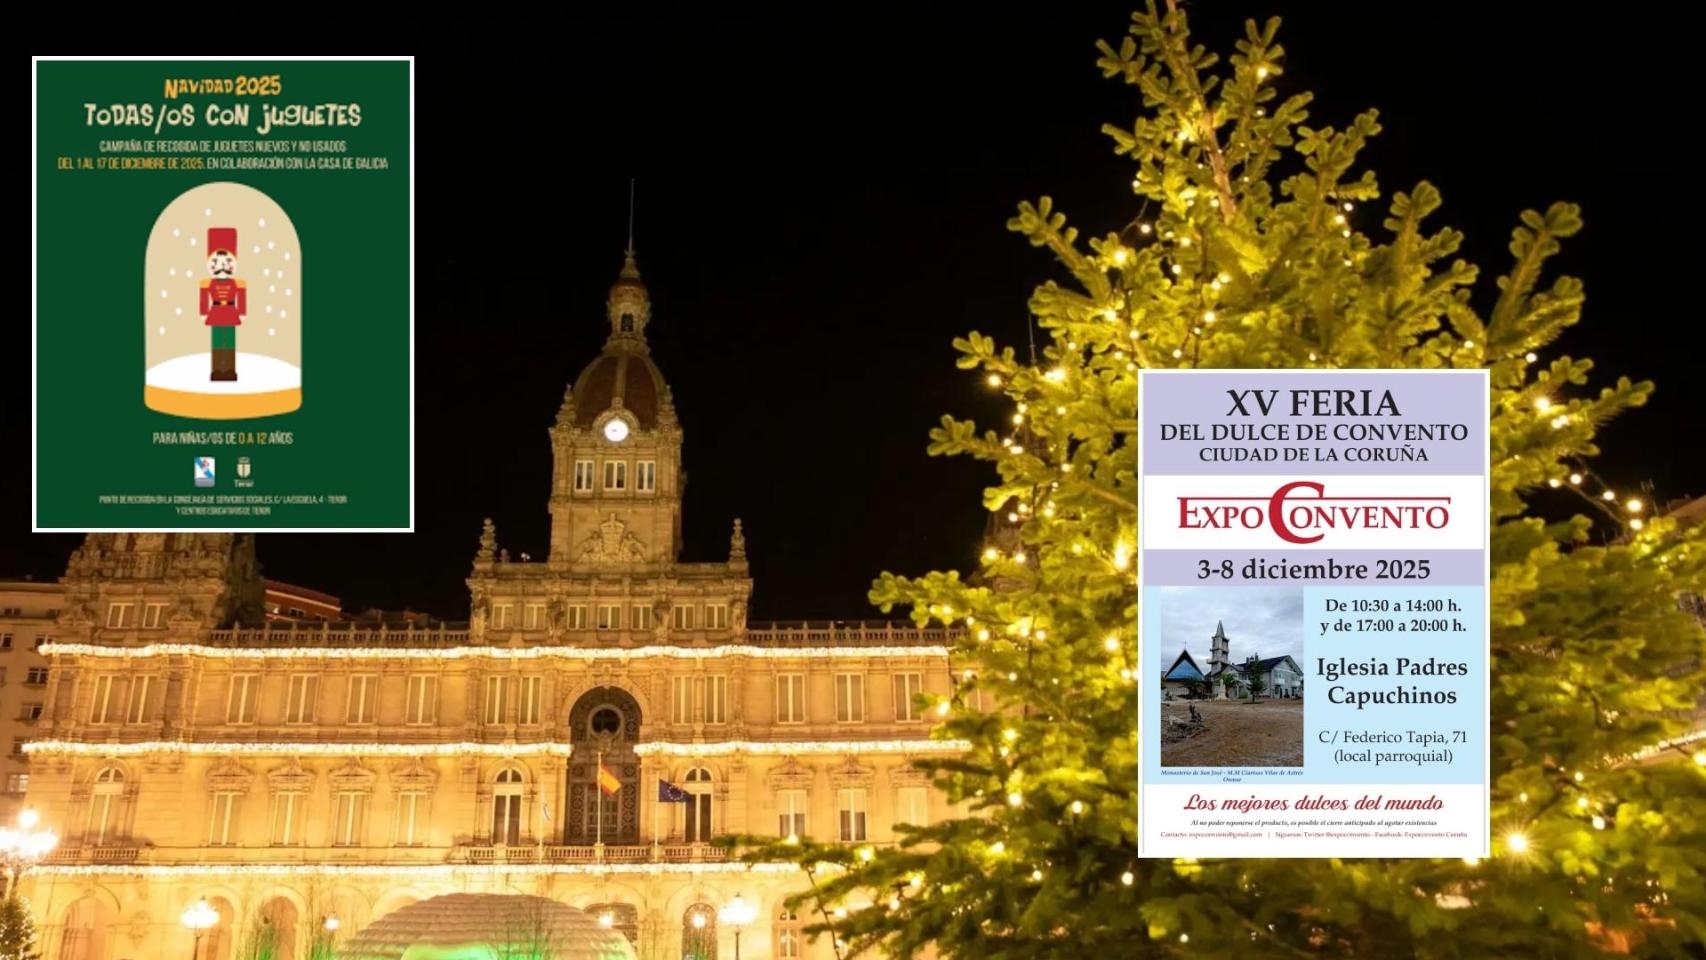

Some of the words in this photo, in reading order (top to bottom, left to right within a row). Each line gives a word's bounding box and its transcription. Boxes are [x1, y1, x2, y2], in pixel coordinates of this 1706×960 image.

[235, 75, 282, 96] 2025
[99, 139, 142, 153] CAMPAÑA
[144, 140, 155, 153] DE
[157, 140, 198, 153] RECOGIDA
[200, 140, 211, 153] DE
[214, 140, 254, 153] JUGUETES
[255, 140, 290, 153] NUEVOS
[290, 140, 297, 153] Y
[299, 140, 312, 153] NO
[313, 140, 347, 153] USADOS
[58, 157, 73, 169] DEL
[82, 157, 94, 169] AL
[98, 157, 107, 169] 17
[109, 157, 120, 169] DE
[121, 157, 164, 169] DICIEMBRE
[168, 157, 179, 169] DE
[207, 157, 219, 169] EN
[285, 157, 303, 169] CON
[305, 157, 316, 169] LA
[318, 157, 341, 169] CASA
[343, 157, 354, 169] DE
[355, 157, 388, 169] GALICIA
[1226, 389, 1279, 417] XV
[1289, 389, 1402, 417] FERIA
[153, 432, 178, 445] PARA
[179, 431, 223, 445] NIÑAS/OS
[225, 432, 237, 445] DE
[247, 432, 254, 445] A
[257, 432, 267, 445] 12
[268, 431, 294, 445] AÑOS
[1160, 424, 1205, 441] DEL
[1212, 424, 1290, 441] DULCE
[1297, 424, 1327, 441] DE
[1334, 423, 1469, 442] CONVENTO
[1200, 448, 1278, 462] CIUDAD
[1283, 448, 1310, 462] DE
[1314, 448, 1338, 462] LA
[1344, 444, 1429, 462] CORUÑA
[1197, 560, 1234, 580] 3-8
[1242, 559, 1368, 580] diciembre
[1376, 560, 1430, 580] 2025
[1325, 599, 1347, 612] De
[1352, 599, 1389, 612] 10:30
[1393, 602, 1401, 612] a
[1407, 599, 1444, 612] 14:00
[1447, 599, 1462, 612] h.
[1320, 623, 1330, 636] y
[1334, 618, 1353, 632] de
[1357, 619, 1394, 632] 17:00
[1398, 622, 1406, 632] a
[1411, 619, 1449, 632] 20:00
[1452, 618, 1467, 632] h.
[1317, 657, 1389, 681] Iglesia
[1395, 657, 1468, 676] Padres
[1327, 685, 1457, 709] Capuchinos
[1318, 731, 1338, 745] C/
[1343, 731, 1402, 744] Federico
[1407, 731, 1449, 747] Tapia,
[1453, 731, 1467, 744] 71
[1334, 749, 1371, 766] (local
[1375, 749, 1453, 767] parroquial)
[1183, 793, 1218, 811] Los
[1221, 795, 1289, 813] mejores
[1294, 794, 1348, 811] dulces
[1354, 795, 1382, 811] del
[1385, 795, 1445, 811] mundo
